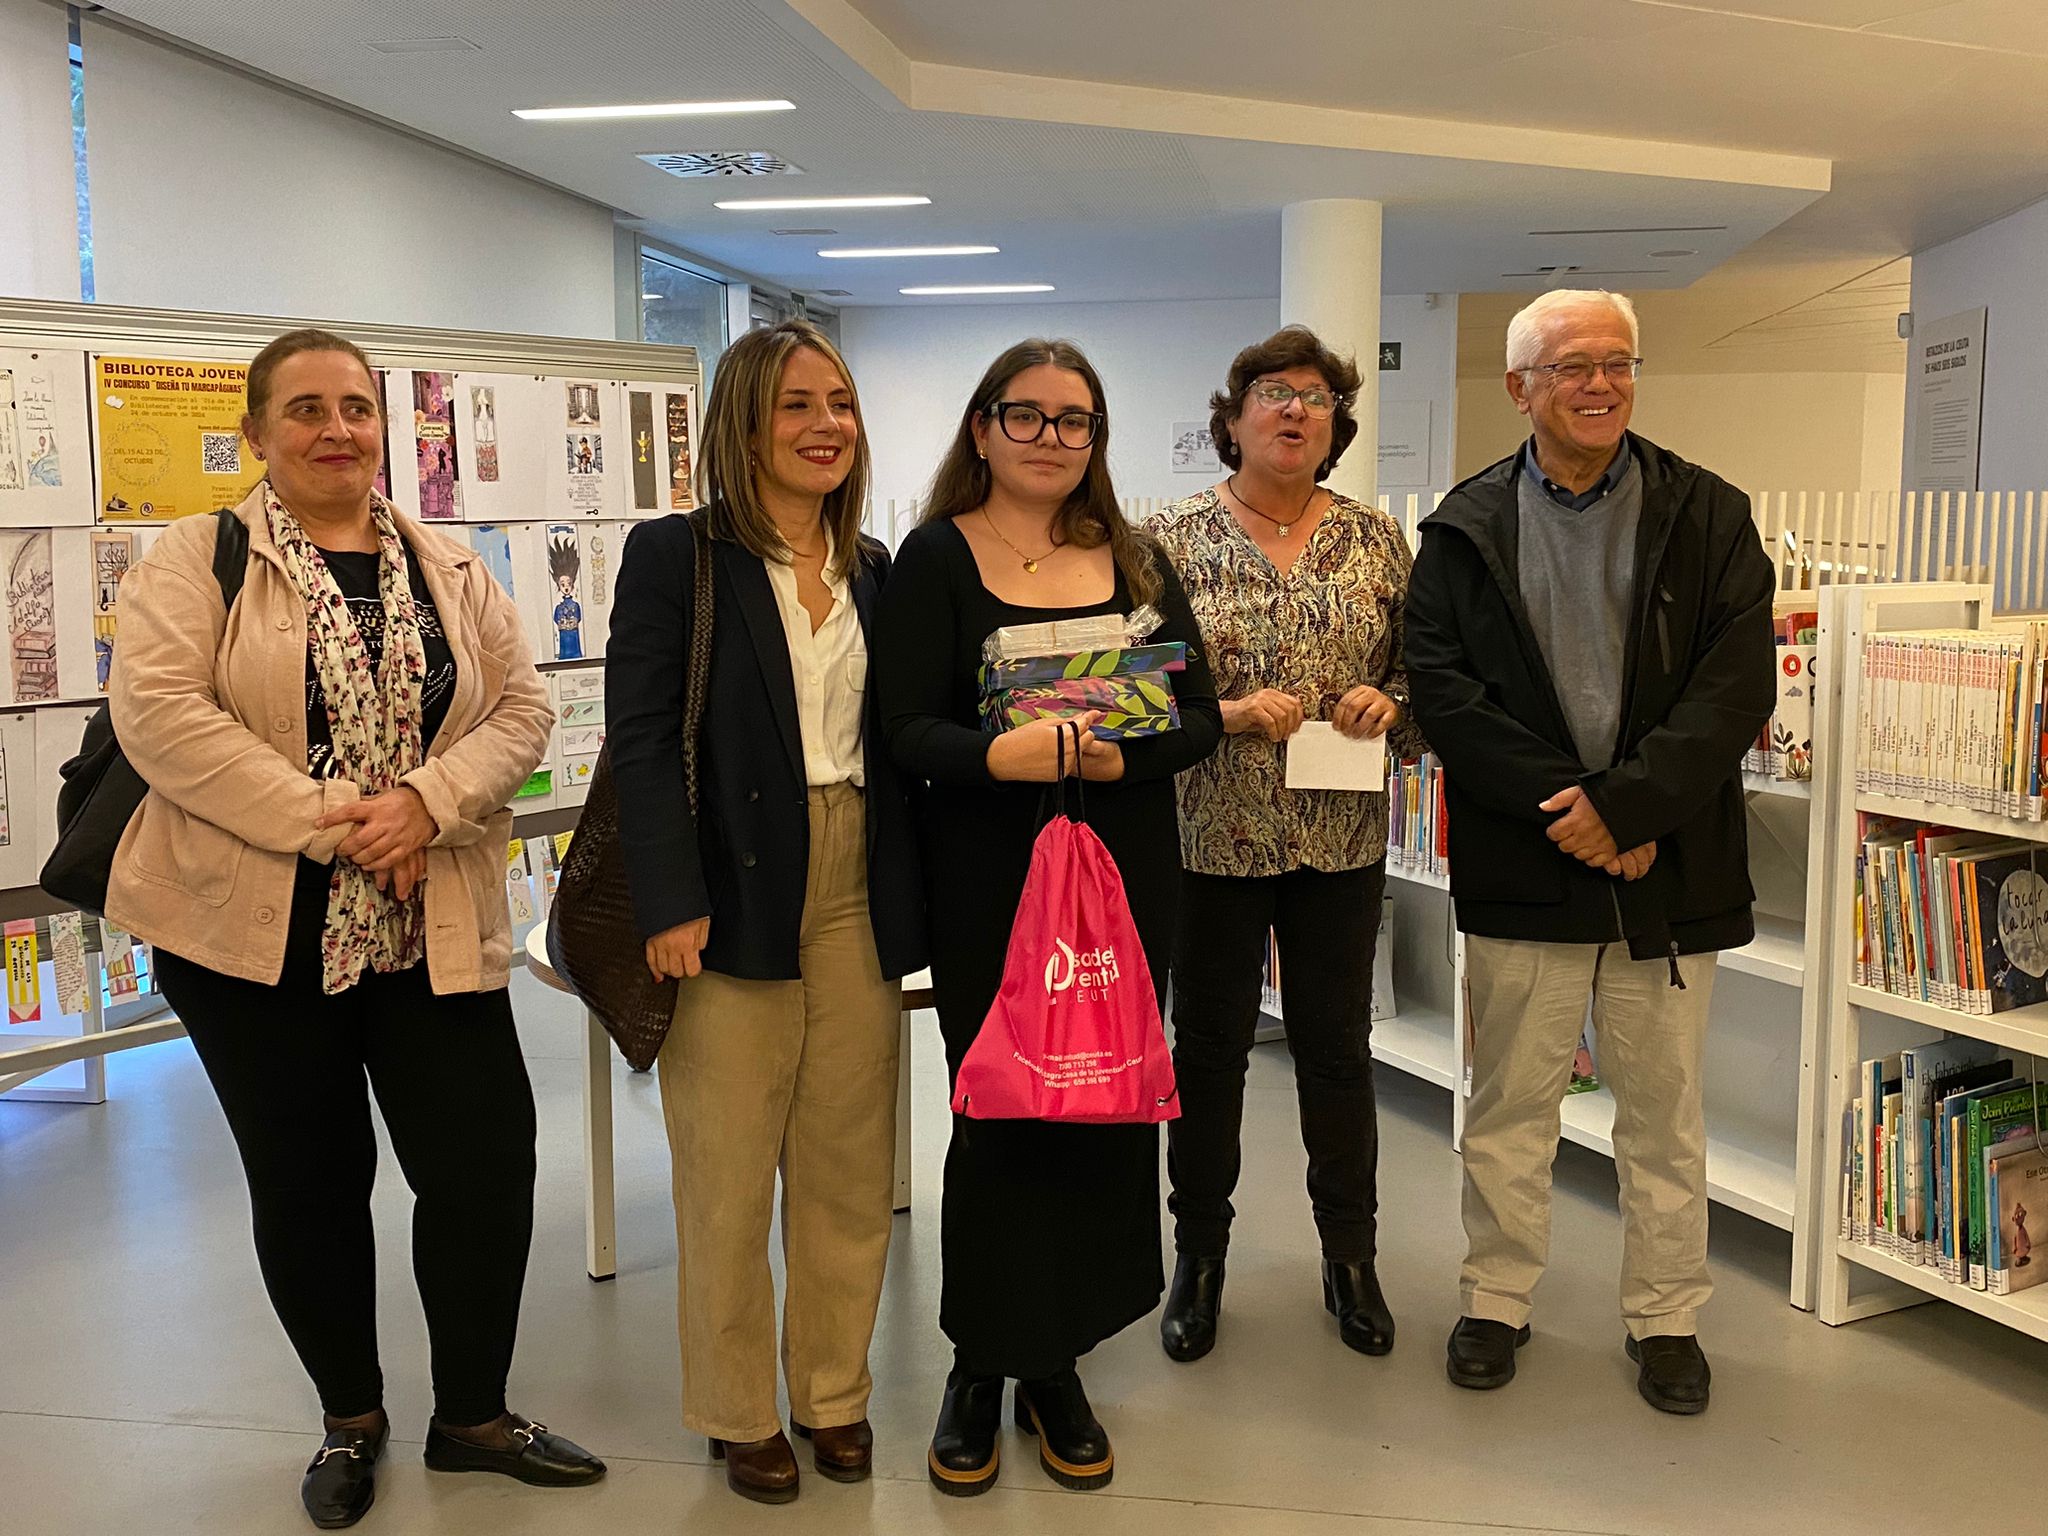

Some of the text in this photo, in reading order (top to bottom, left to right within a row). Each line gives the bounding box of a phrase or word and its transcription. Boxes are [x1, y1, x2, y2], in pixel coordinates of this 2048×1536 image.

[104, 362, 246, 380] BIBLIOTECA JOVEN
[104, 378, 112, 388] IV
[114, 379, 150, 390] CONCURSO
[181, 382, 190, 391] TU
[2006, 882, 2042, 908] tocar
[2002, 916, 2018, 936] la
